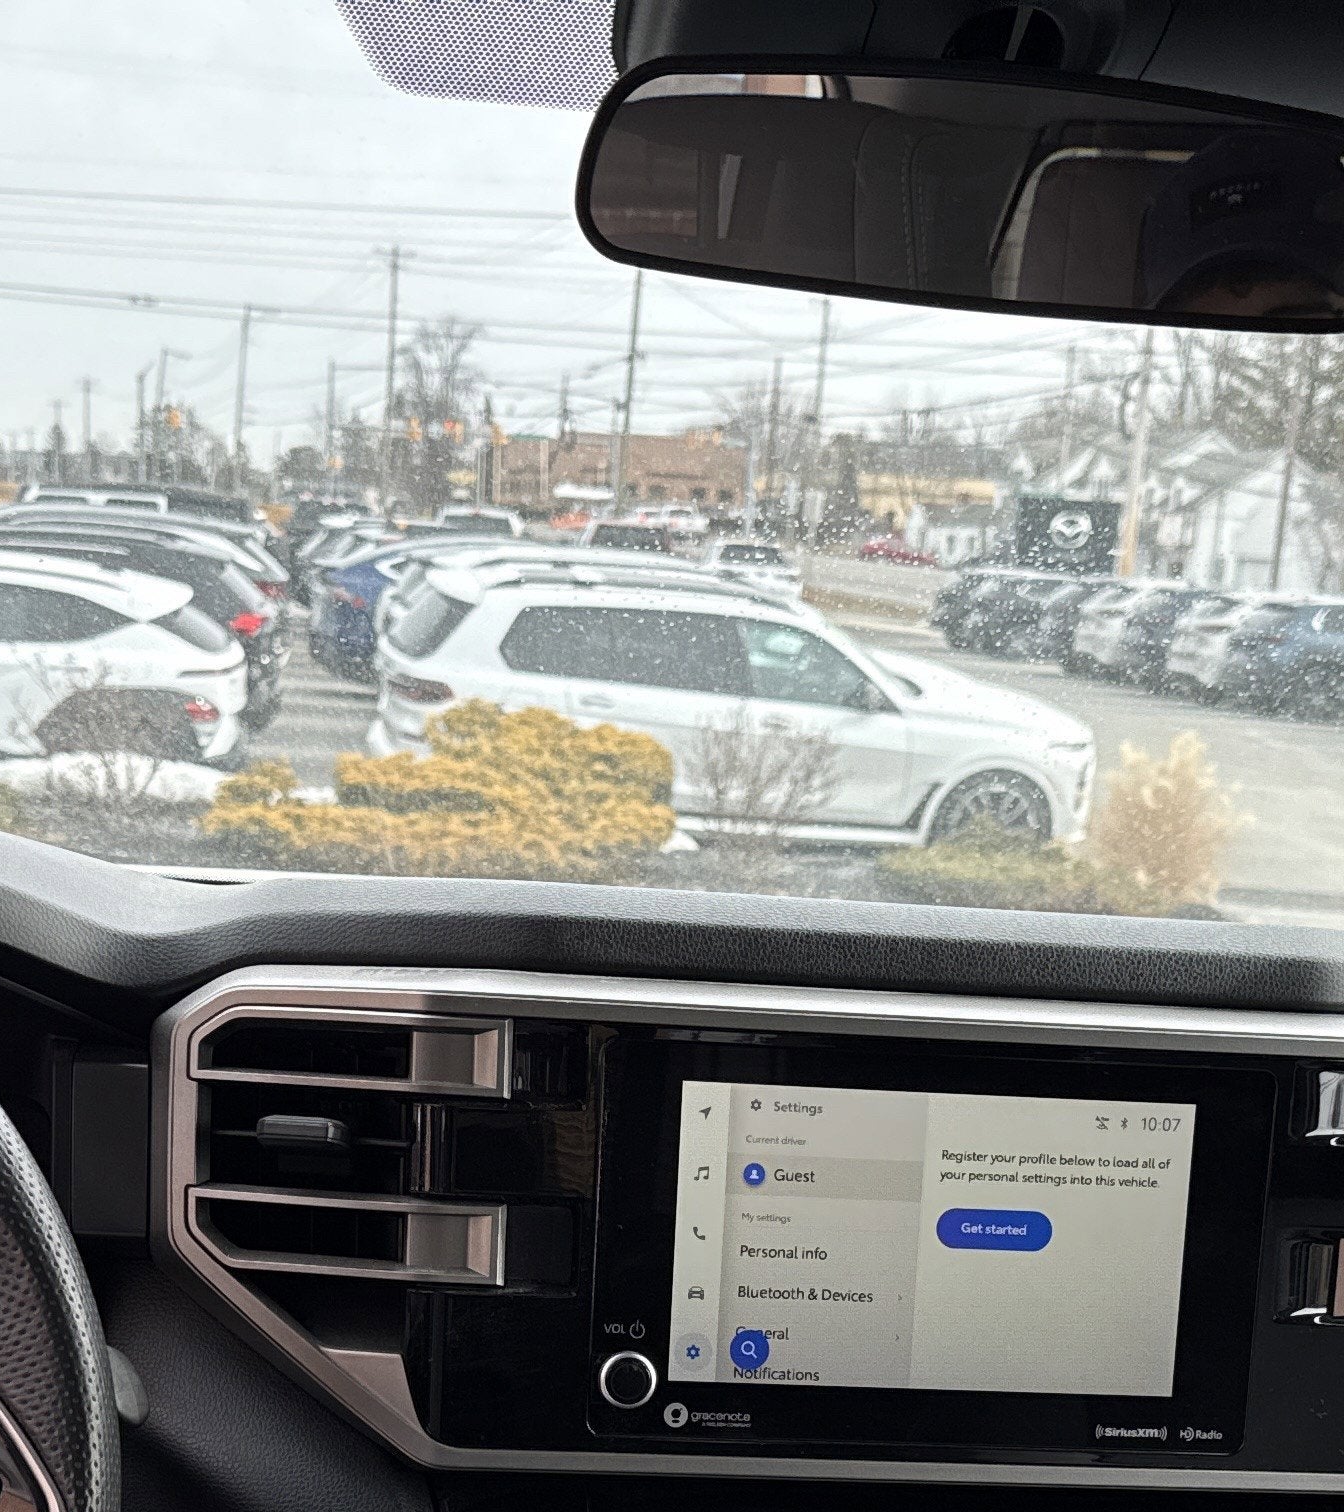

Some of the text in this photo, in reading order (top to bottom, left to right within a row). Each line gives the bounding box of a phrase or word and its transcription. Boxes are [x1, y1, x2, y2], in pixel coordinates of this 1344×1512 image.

[773, 1100, 824, 1116] Settings
[1141, 1118, 1182, 1132] 10:07
[745, 1134, 807, 1147] Current driver
[941, 1149, 1173, 1170] Register your profile below to load all of
[773, 1167, 816, 1184] Guest
[939, 1170, 967, 1183] your
[967, 1171, 1019, 1185] personal
[1021, 1173, 1068, 1187] settings
[1069, 1175, 1093, 1187] into
[1095, 1176, 1116, 1188] this
[740, 1212, 792, 1225] My settings
[960, 1222, 1028, 1237] Get started
[739, 1244, 828, 1262] Personal info
[737, 1285, 874, 1304] Bluetooth & Devices
[603, 1323, 626, 1335] VOL
[733, 1366, 820, 1382] Notifications
[691, 1411, 751, 1422] gracenote
[1104, 1426, 1159, 1438] SiriusXM
[1196, 1430, 1223, 1440] Radio
